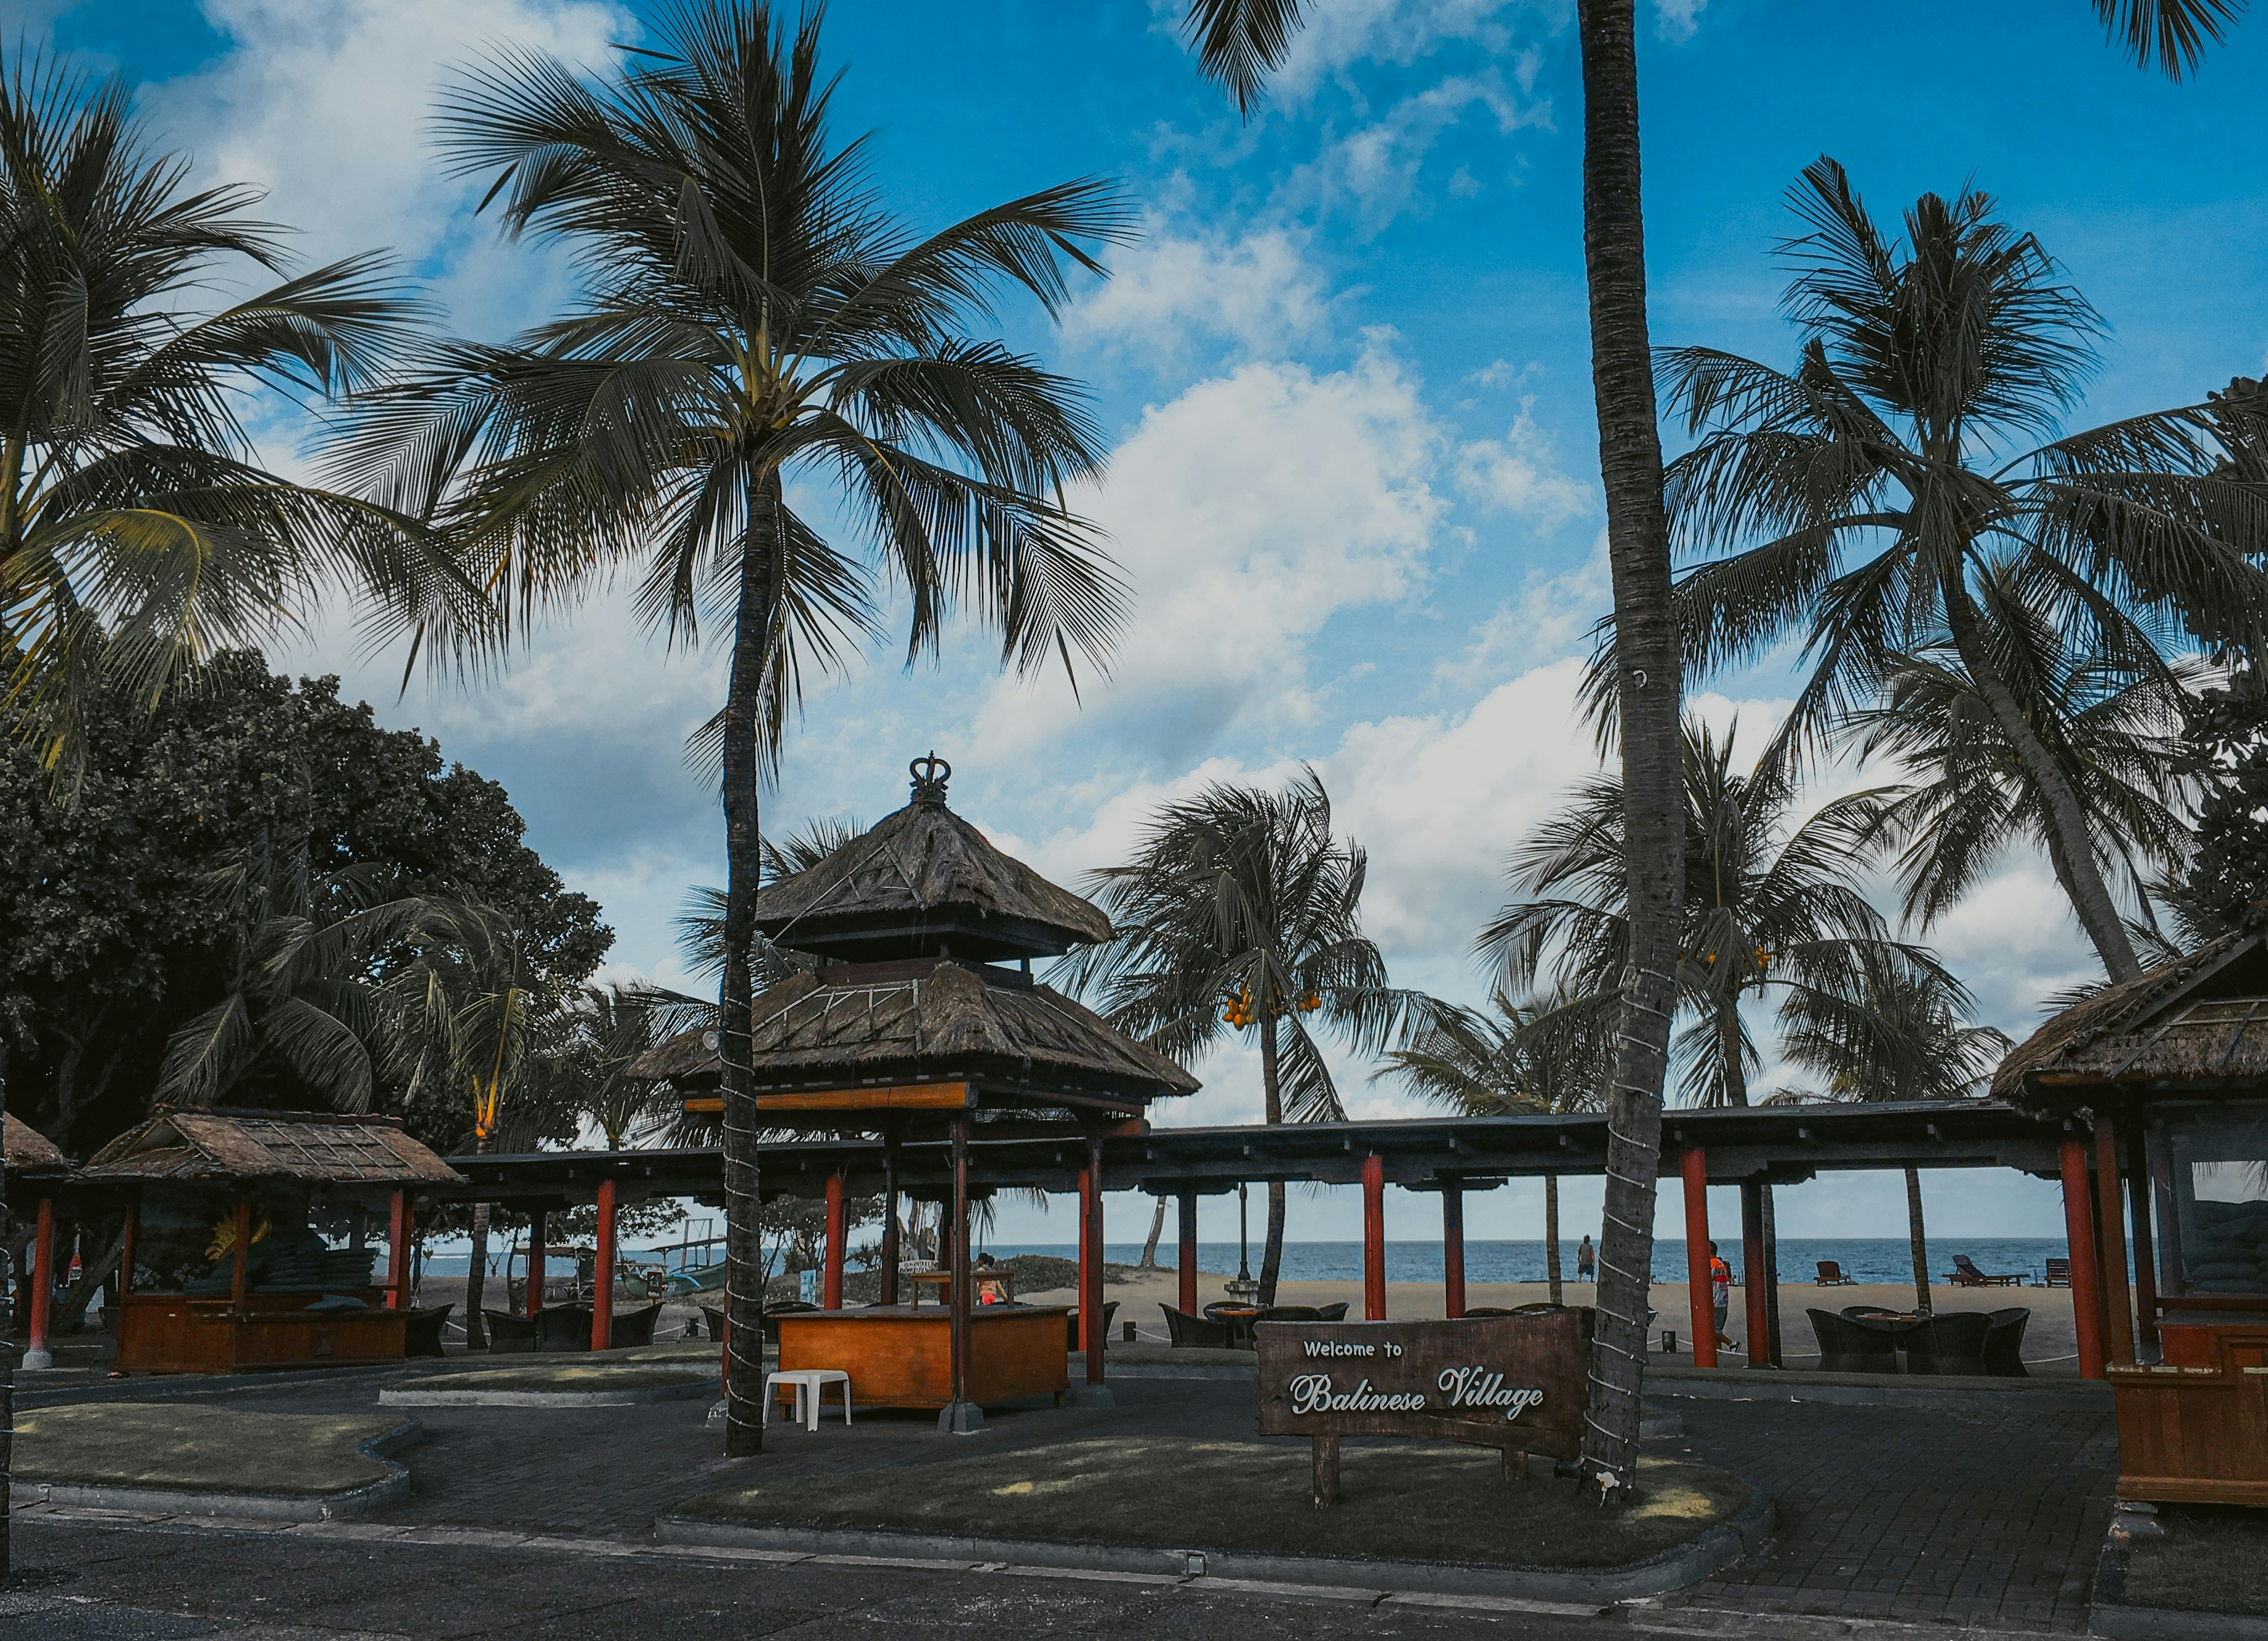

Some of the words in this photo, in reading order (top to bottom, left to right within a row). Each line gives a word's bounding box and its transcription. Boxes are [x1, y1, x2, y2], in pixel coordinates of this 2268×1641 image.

[1303, 1340, 1376, 1358] Welcome
[1384, 1341, 1403, 1358] to
[1290, 1374, 1426, 1415] Balinese
[1438, 1366, 1544, 1421] Village
